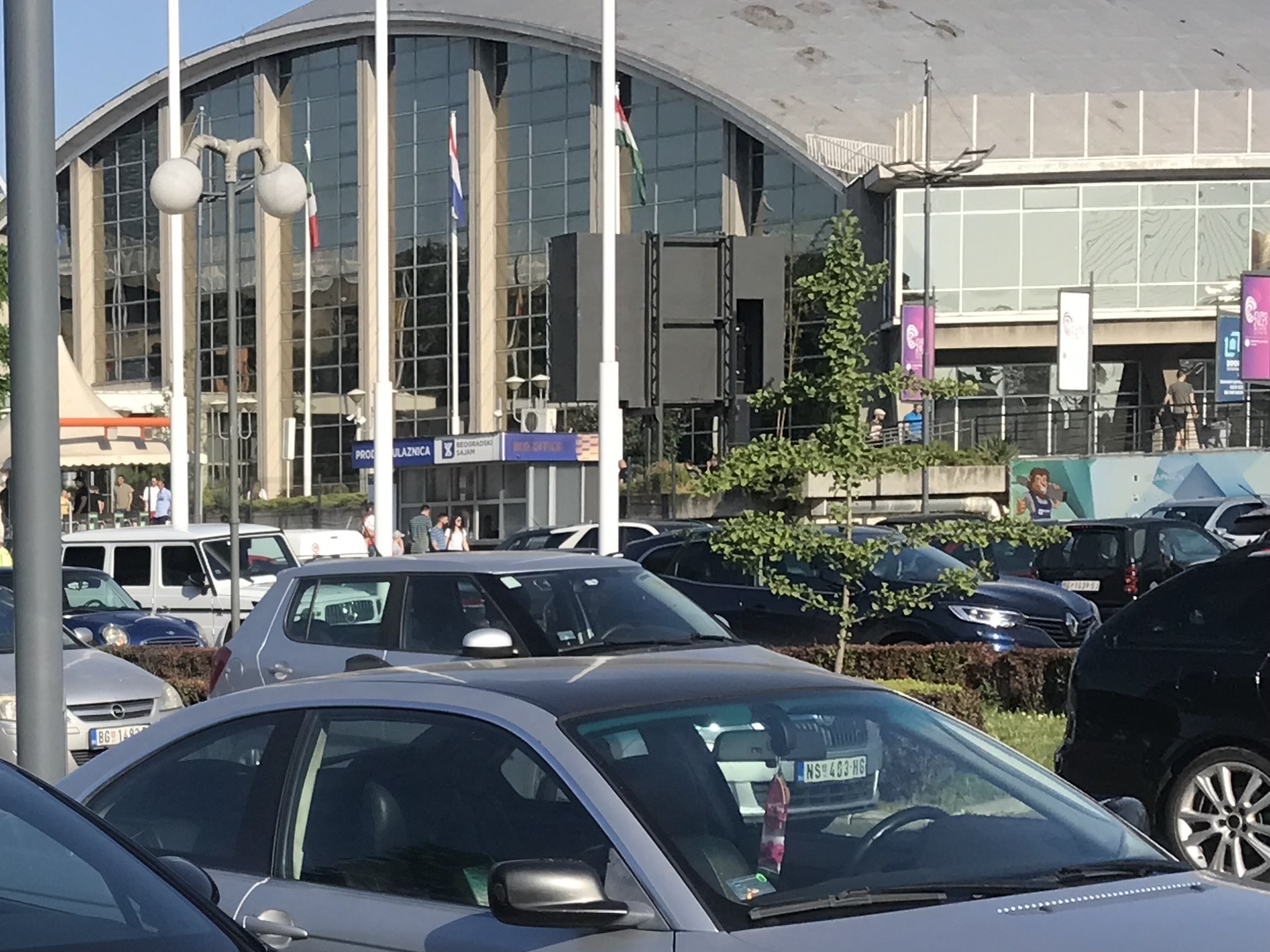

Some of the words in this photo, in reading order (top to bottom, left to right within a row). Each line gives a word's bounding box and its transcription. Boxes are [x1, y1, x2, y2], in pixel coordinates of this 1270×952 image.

[456, 440, 493, 448] BEOGRADSKI
[393, 446, 432, 458] ULAZNICA
[98, 730, 110, 744] BG
[806, 763, 821, 780] NS
